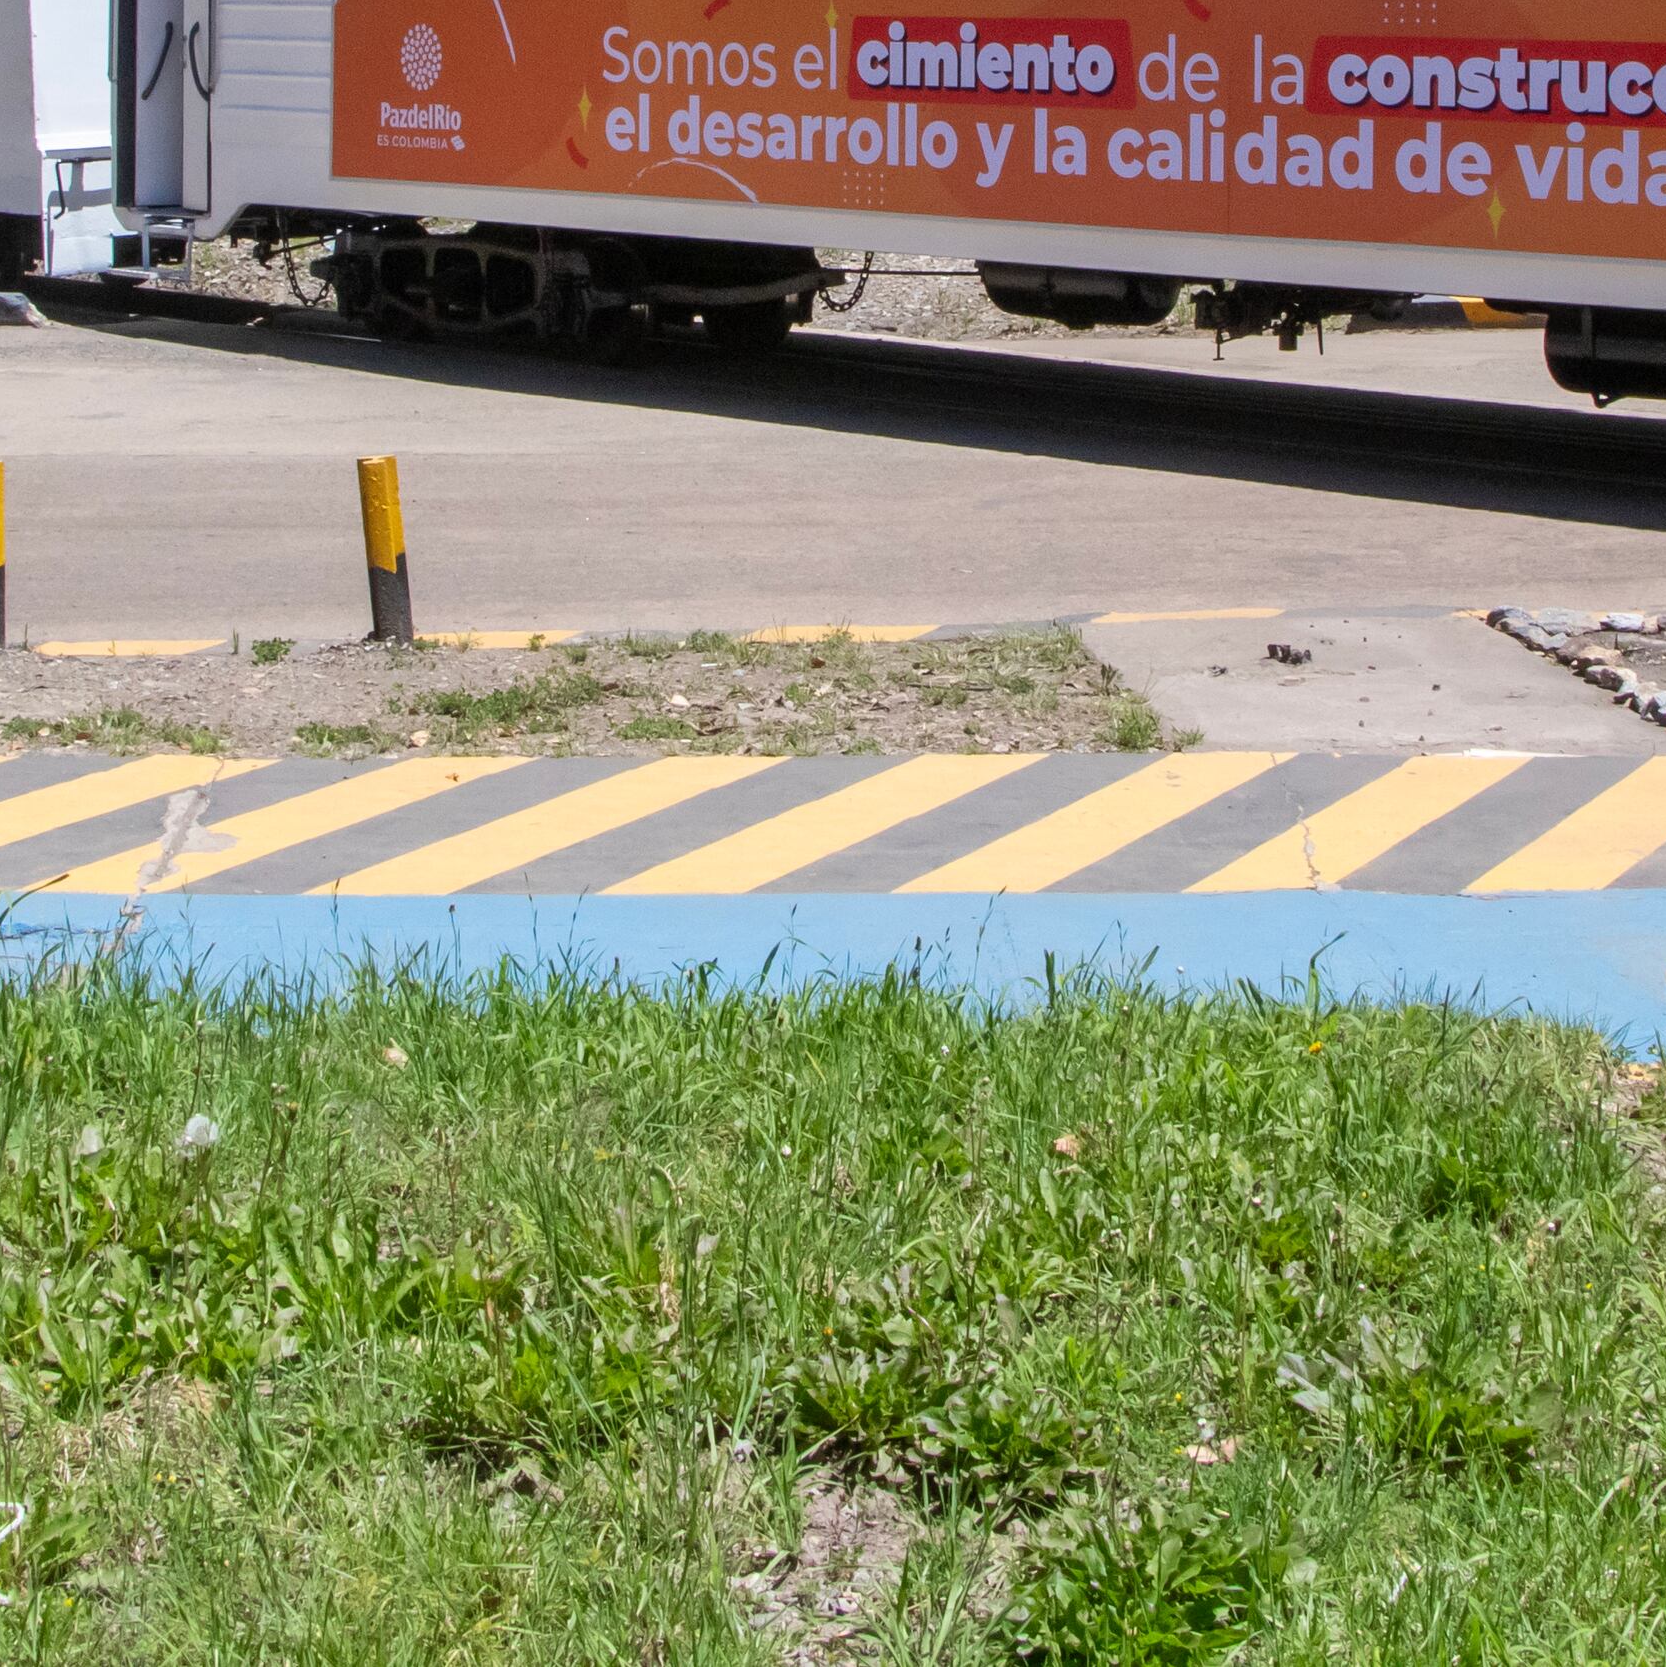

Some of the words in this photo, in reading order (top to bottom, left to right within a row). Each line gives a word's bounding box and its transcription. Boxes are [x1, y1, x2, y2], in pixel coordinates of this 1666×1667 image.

[603, 26, 777, 90] Somos
[794, 27, 838, 90] el
[856, 22, 1115, 94] cimiento
[1139, 35, 1220, 102] de
[1254, 35, 1306, 105] la
[377, 134, 389, 147] ES
[392, 136, 448, 149] COLOMBIA
[380, 102, 462, 131] PazdelRío
[605, 99, 650, 152] el
[667, 95, 959, 168] desarrollo
[974, 121, 1014, 187] y
[1034, 108, 1088, 176] la
[1107, 109, 1375, 190] calidad
[1395, 121, 1493, 197] de
